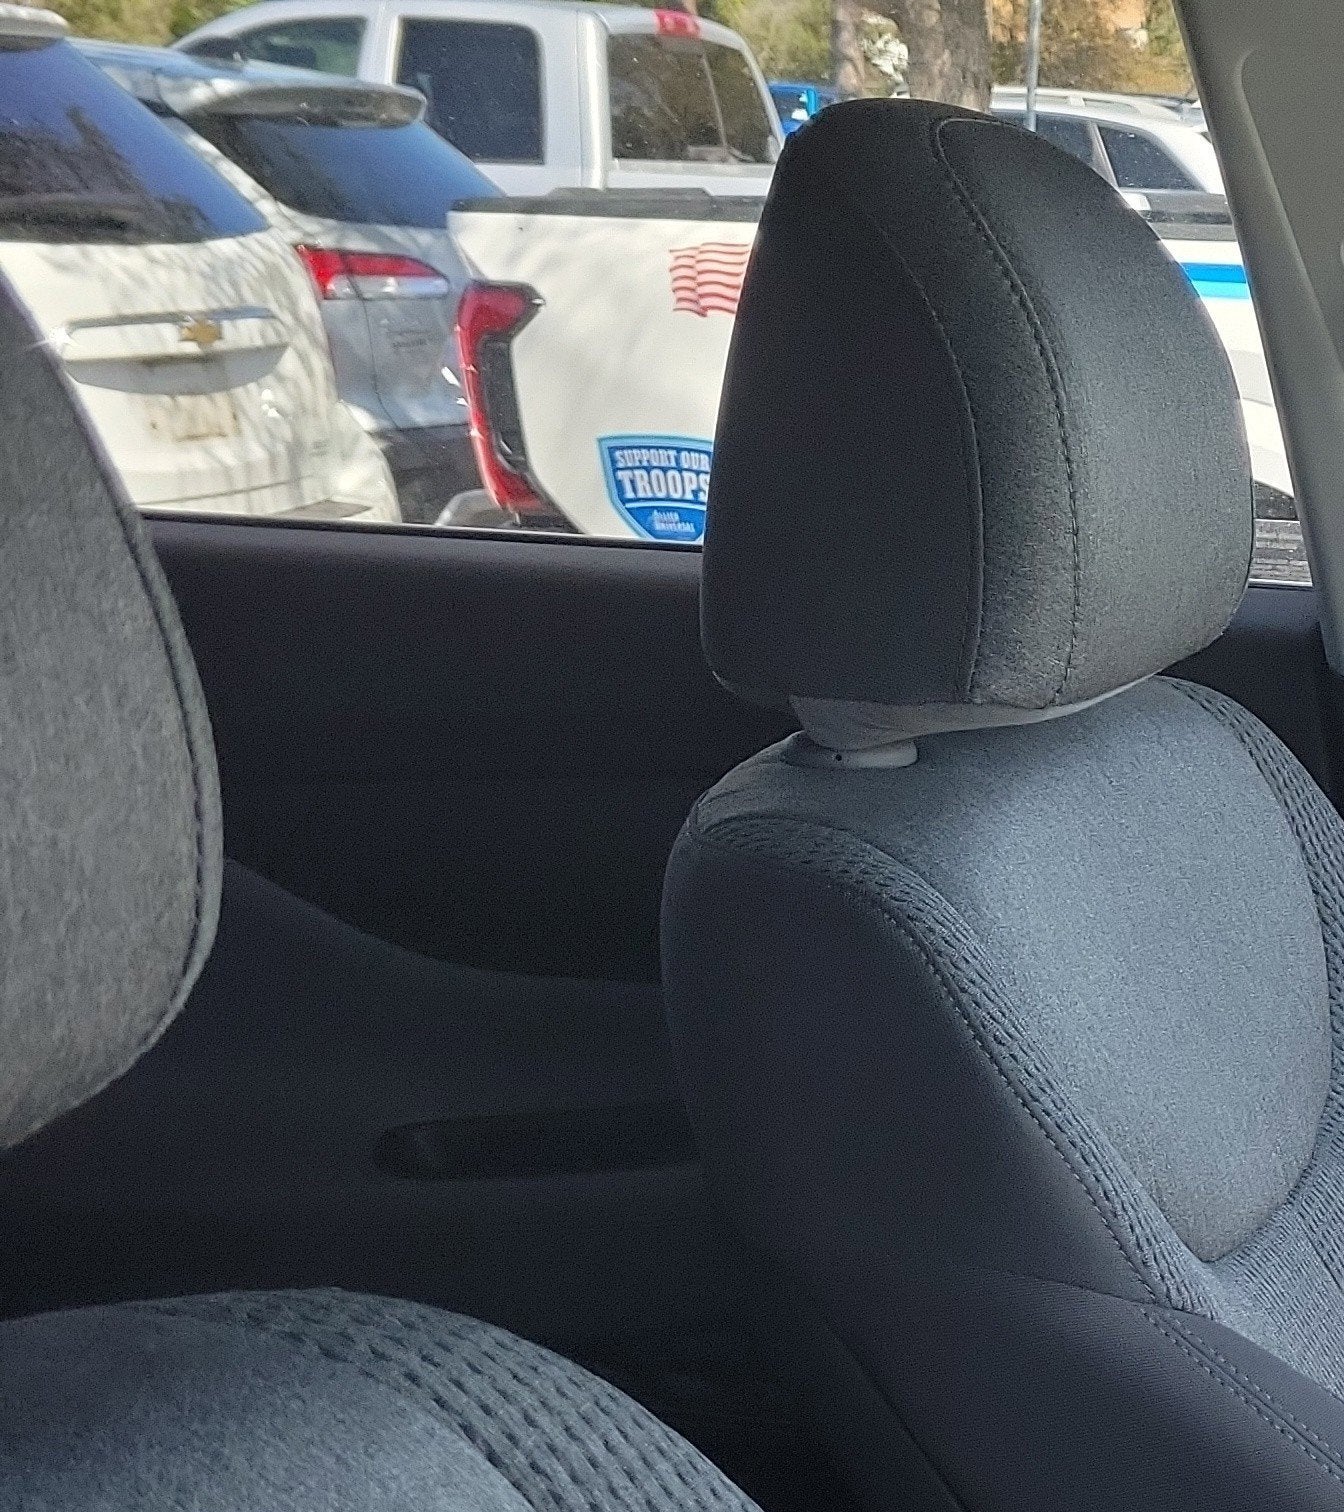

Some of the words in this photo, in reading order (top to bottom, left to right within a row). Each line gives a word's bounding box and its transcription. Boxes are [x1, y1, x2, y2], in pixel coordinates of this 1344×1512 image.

[614, 448, 678, 468] SUPPORT
[680, 450, 710, 471] OUR
[616, 468, 709, 502] TROOPS
